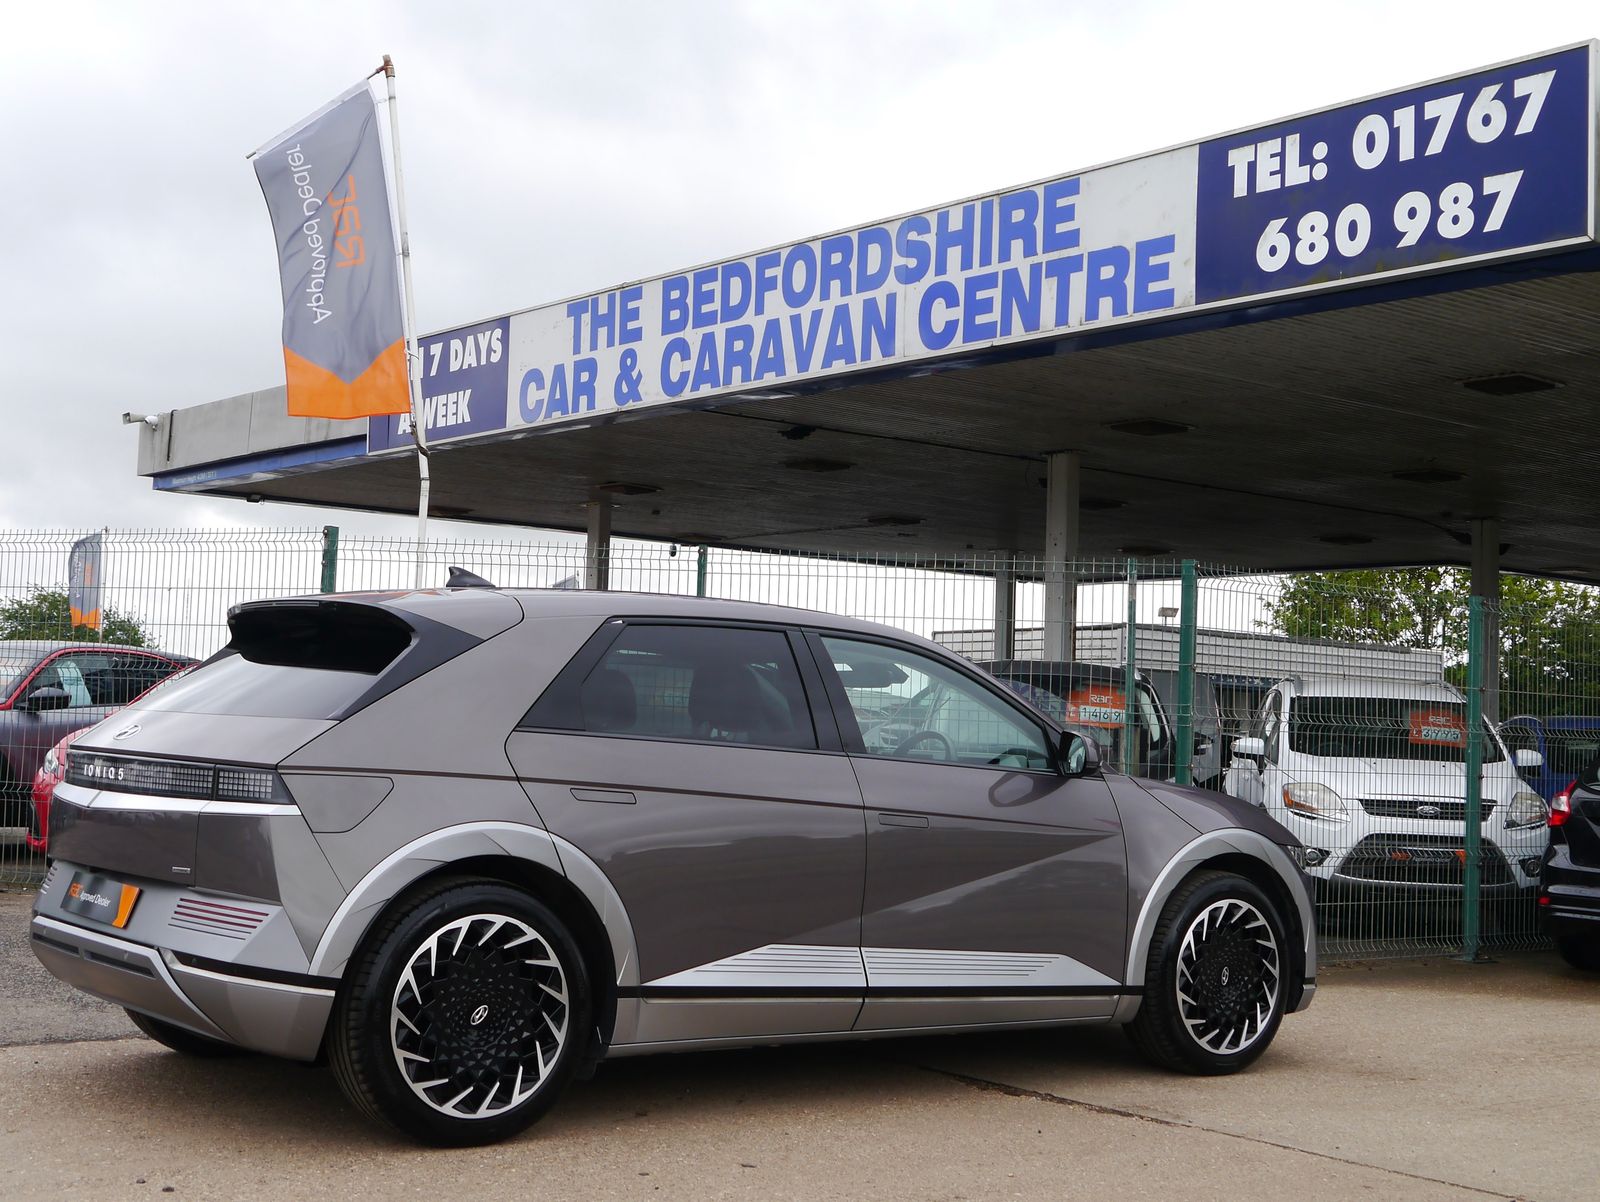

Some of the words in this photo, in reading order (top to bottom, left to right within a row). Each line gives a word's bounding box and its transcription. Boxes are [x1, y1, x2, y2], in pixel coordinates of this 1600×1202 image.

[1227, 133, 1329, 198] TEL:
[1352, 69, 1557, 170] 01767
[567, 286, 643, 355] THE
[661, 177, 1081, 337] BEDFORDSHIRE
[1256, 203, 1371, 273] 680
[1393, 169, 1524, 249] 987
[429, 342, 444, 377] 7
[449, 328, 503, 372] DAYS
[519, 357, 598, 424] CAR
[613, 348, 643, 406] &
[660, 291, 897, 398] CARAVAN
[918, 234, 1176, 351] CENTRE
[423, 389, 472, 430] WEEK
[83, 764, 115, 779] IONIQ
[117, 767, 125, 781] 5
